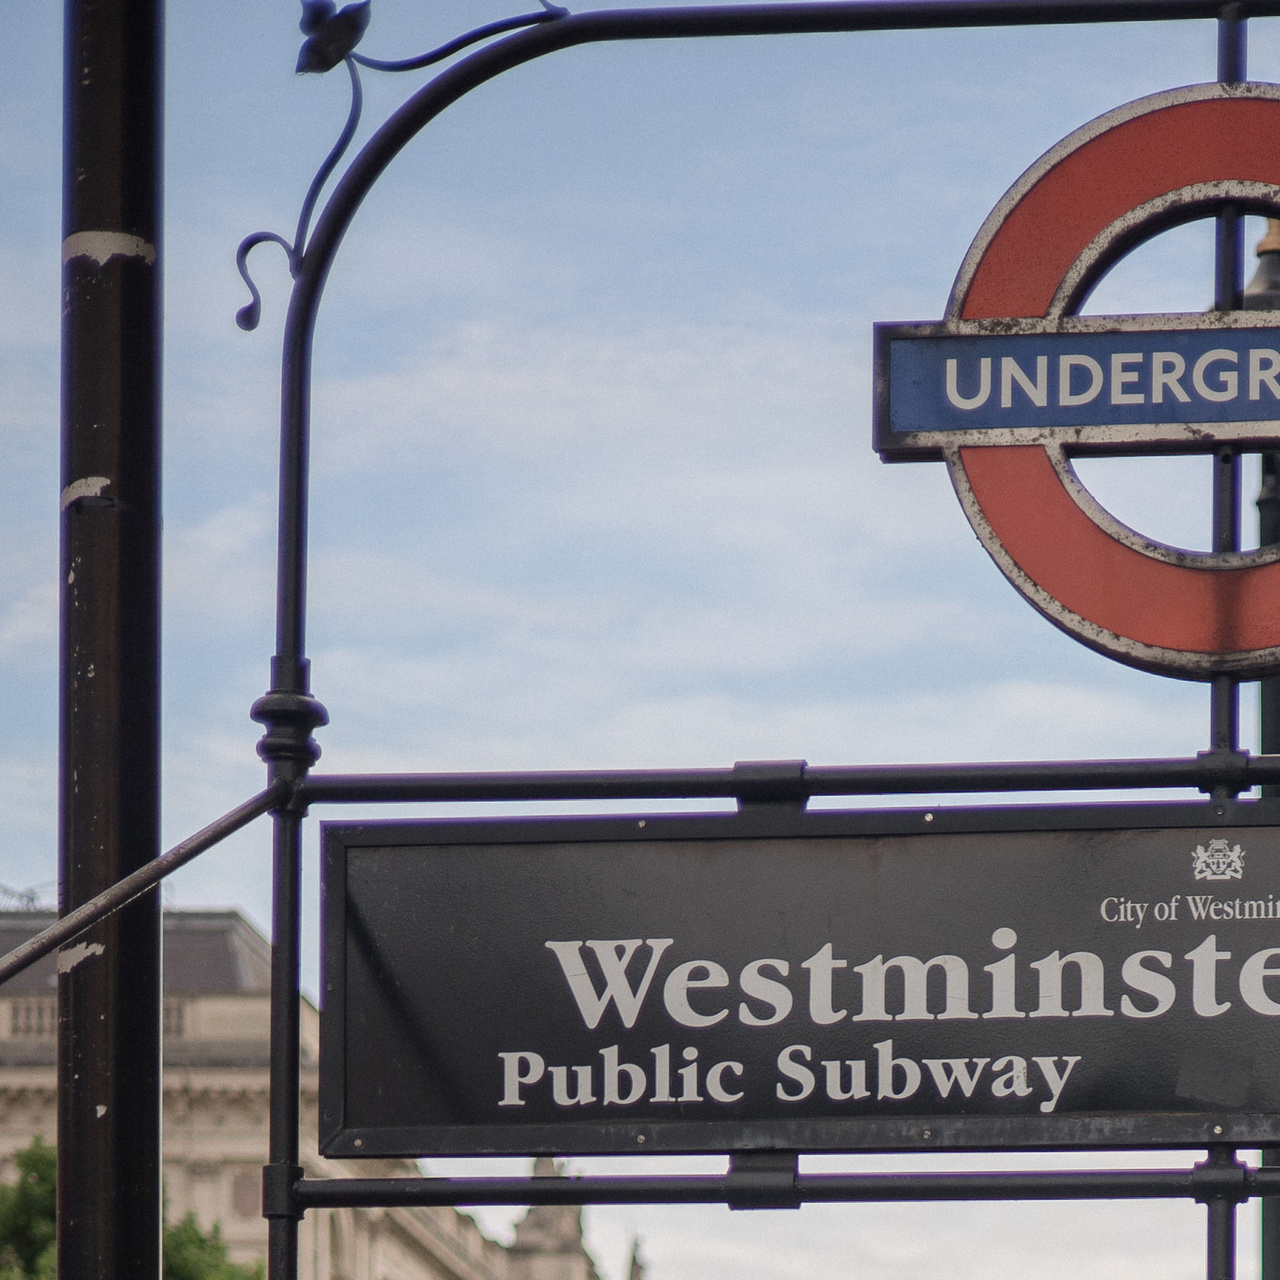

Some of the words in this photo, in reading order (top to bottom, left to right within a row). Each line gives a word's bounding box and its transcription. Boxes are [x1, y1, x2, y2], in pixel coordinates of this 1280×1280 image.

[1100, 897, 1149, 929] City
[1154, 895, 1181, 921] of
[498, 1044, 744, 1107] Public
[776, 1040, 1082, 1113] Subway
